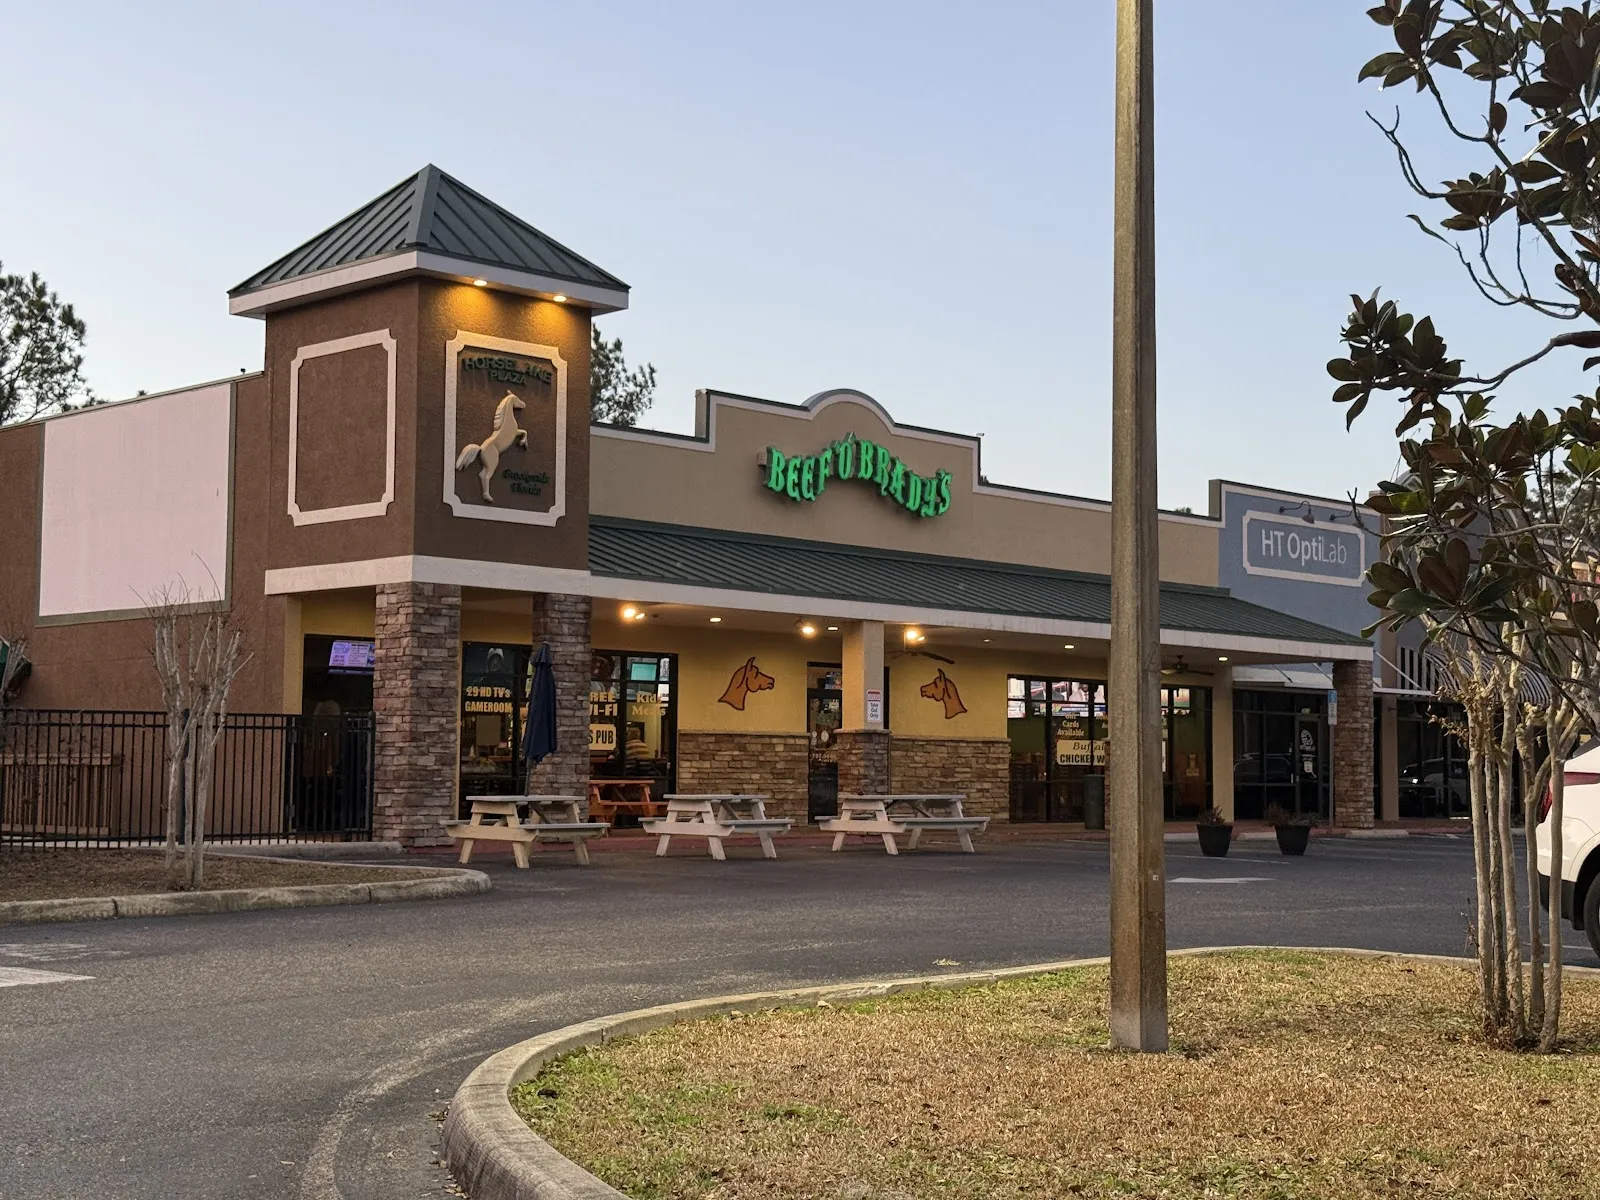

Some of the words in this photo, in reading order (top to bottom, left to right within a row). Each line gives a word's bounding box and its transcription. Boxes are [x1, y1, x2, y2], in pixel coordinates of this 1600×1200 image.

[463, 356, 515, 371] HORSE
[490, 370, 526, 385] PLAZA
[767, 446, 833, 502] BEEF
[1261, 528, 1285, 557] HT
[1287, 532, 1347, 566] OptiLab
[466, 686, 479, 697] 29
[480, 687, 492, 697] HD
[590, 691, 616, 702] REE
[636, 693, 662, 704] Kids
[465, 700, 513, 713] GAMEROOM
[590, 703, 618, 716] I-FI
[1062, 720, 1080, 728] Cards
[596, 730, 614, 744] PUB
[1056, 729, 1085, 737] Available
[1072, 742, 1105, 753] Bufal
